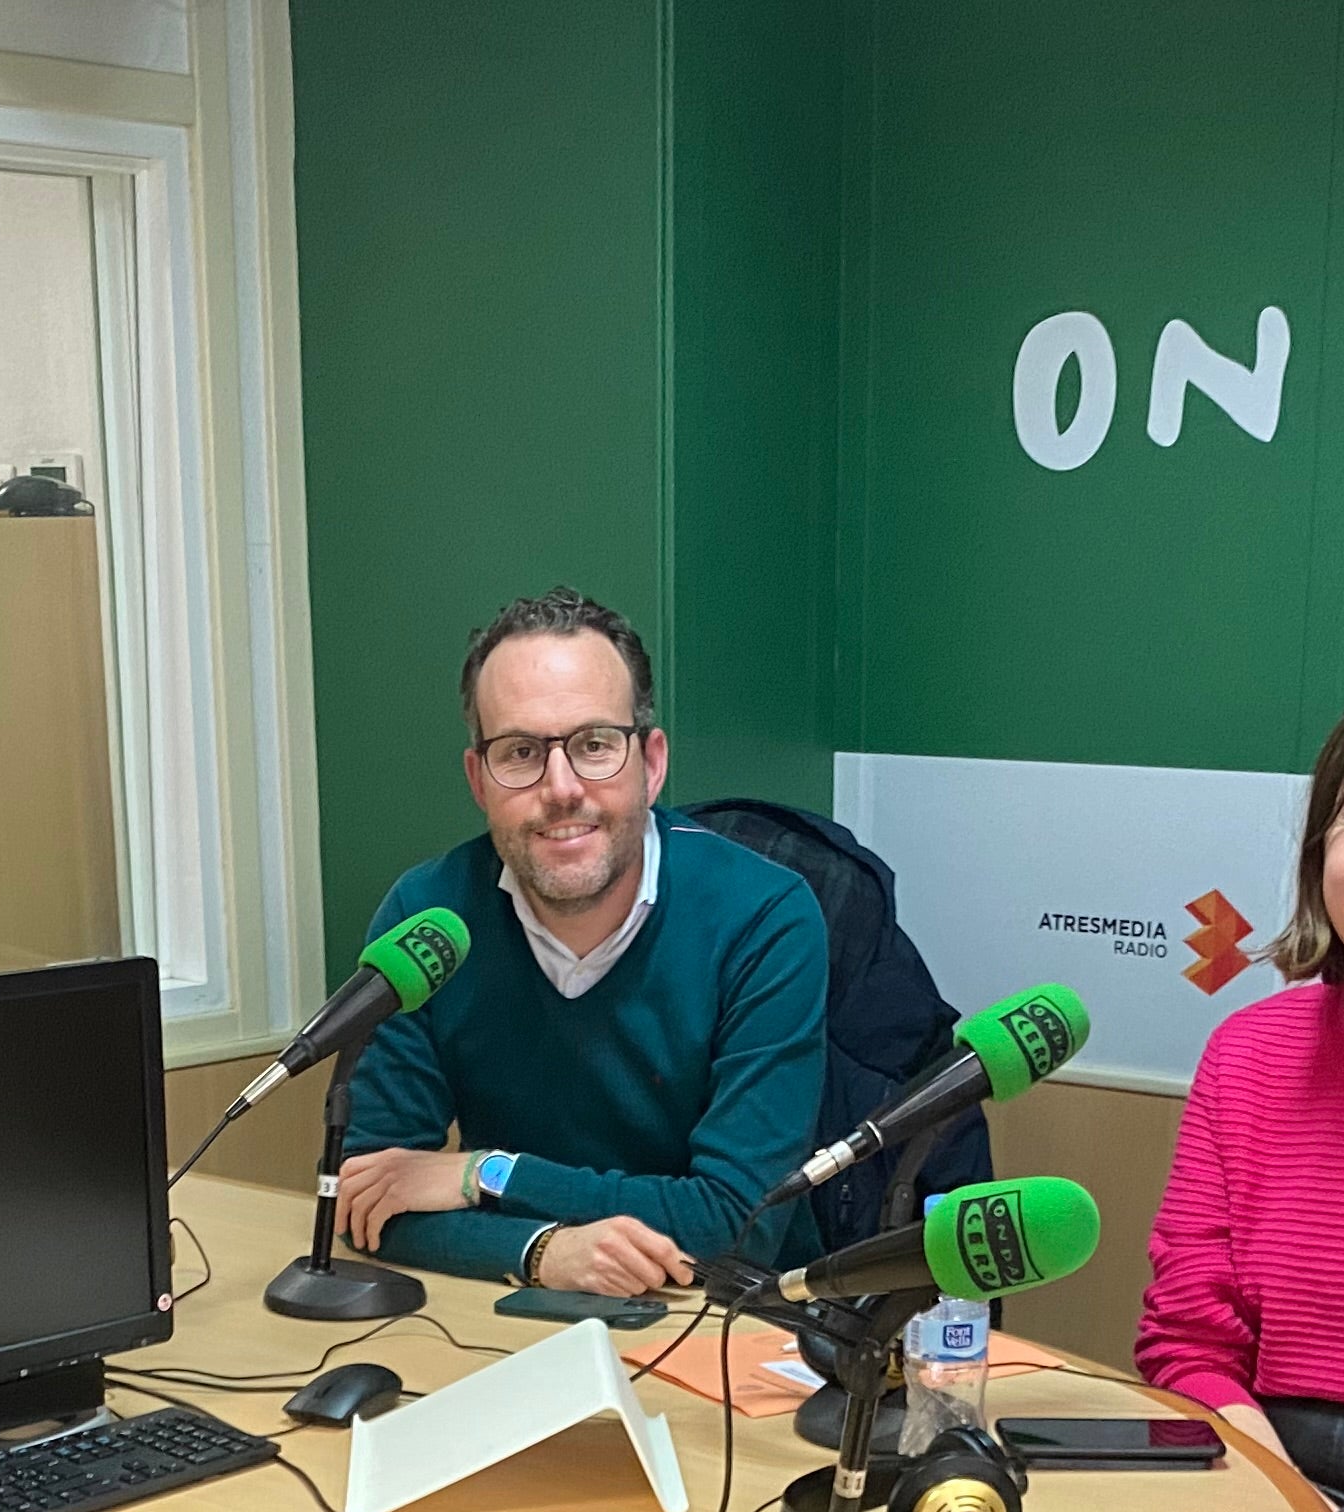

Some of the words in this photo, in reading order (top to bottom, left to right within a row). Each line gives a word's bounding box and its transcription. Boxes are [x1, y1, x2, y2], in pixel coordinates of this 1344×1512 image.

[1038, 912, 1167, 939] ATRESMEDIA
[1113, 940, 1167, 958] RADIO
[1018, 1020, 1047, 1070] CERO
[967, 1213, 996, 1281] CERO
[993, 1205, 1020, 1276] ONDA
